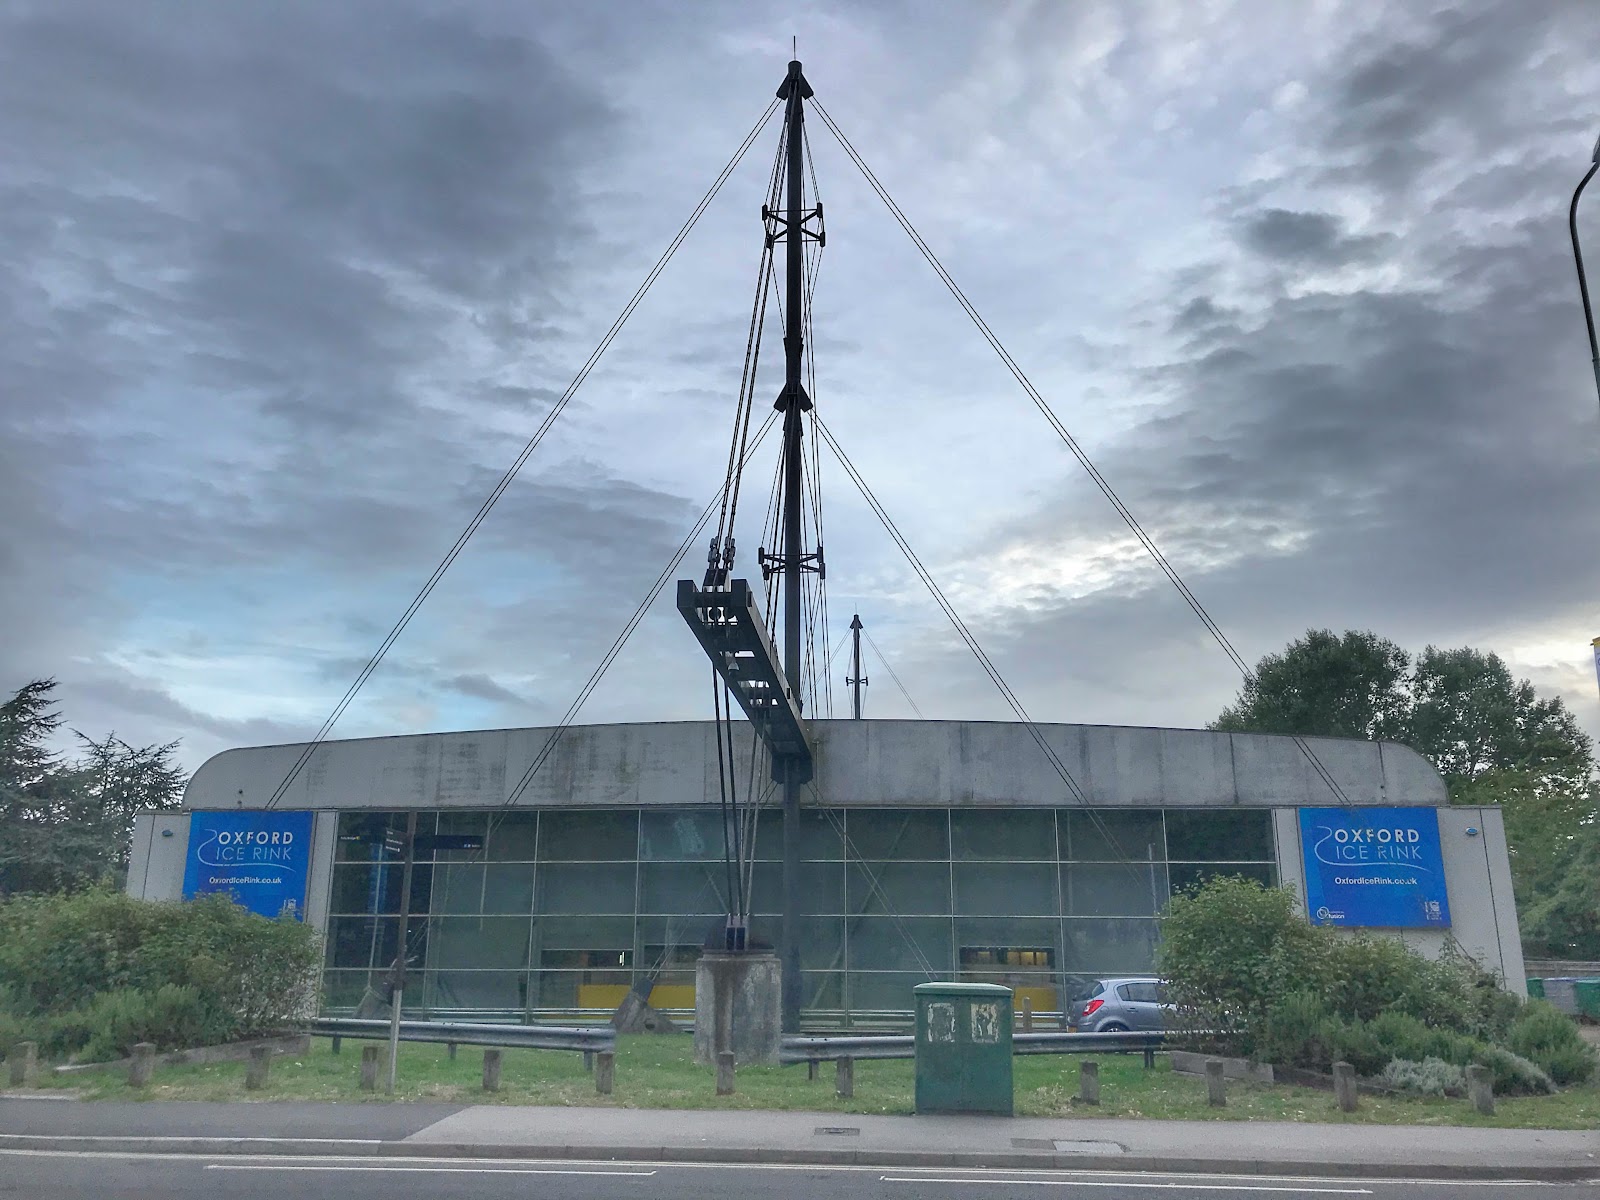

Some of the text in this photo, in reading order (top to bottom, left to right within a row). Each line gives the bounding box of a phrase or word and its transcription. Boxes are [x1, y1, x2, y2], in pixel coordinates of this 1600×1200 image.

[218, 831, 294, 845] OXFORD
[1334, 828, 1420, 843] OXFORD
[216, 846, 292, 860] ICE RINK
[1336, 845, 1422, 860] ICE RINK
[209, 876, 282, 884] OxfordIceRink.co.uk
[1334, 876, 1418, 885] OxfordIceRink.co.uk
